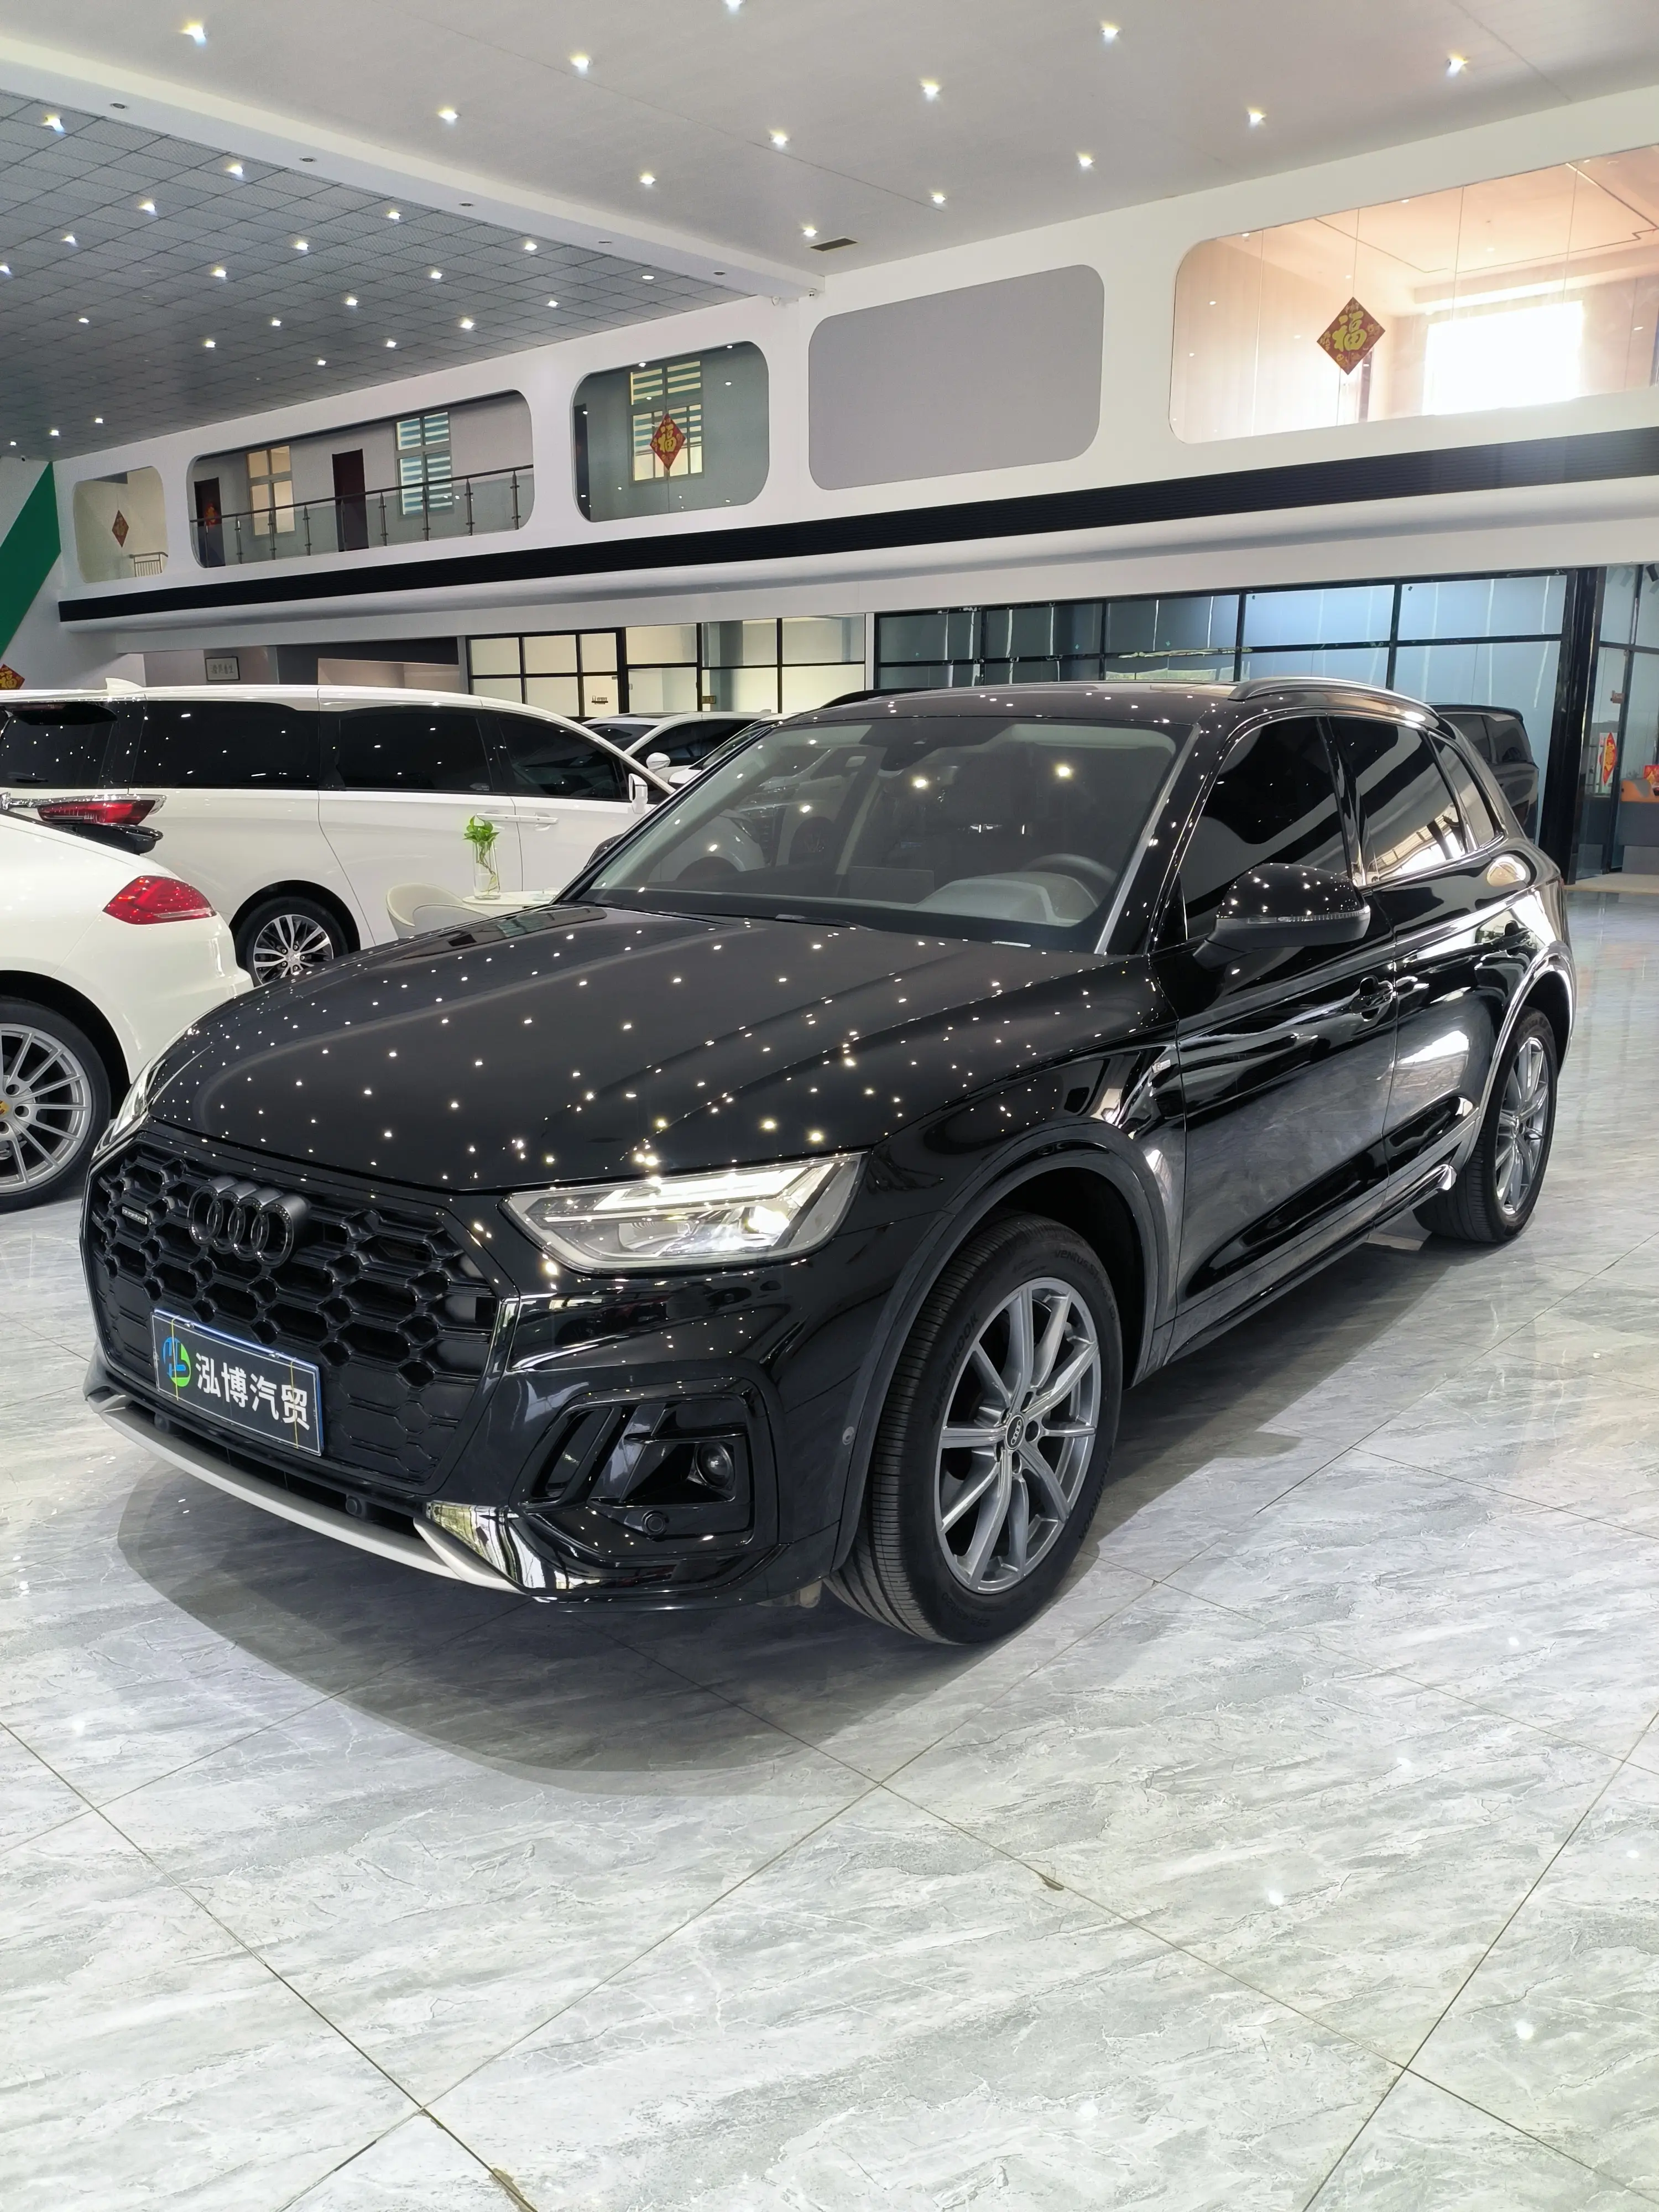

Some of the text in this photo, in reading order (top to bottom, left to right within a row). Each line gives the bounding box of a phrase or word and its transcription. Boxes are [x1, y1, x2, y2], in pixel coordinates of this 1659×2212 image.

[1332, 310, 1368, 352] 福
[658, 423, 677, 453] 福
[195, 1352, 310, 1431] 泓博汽贸
